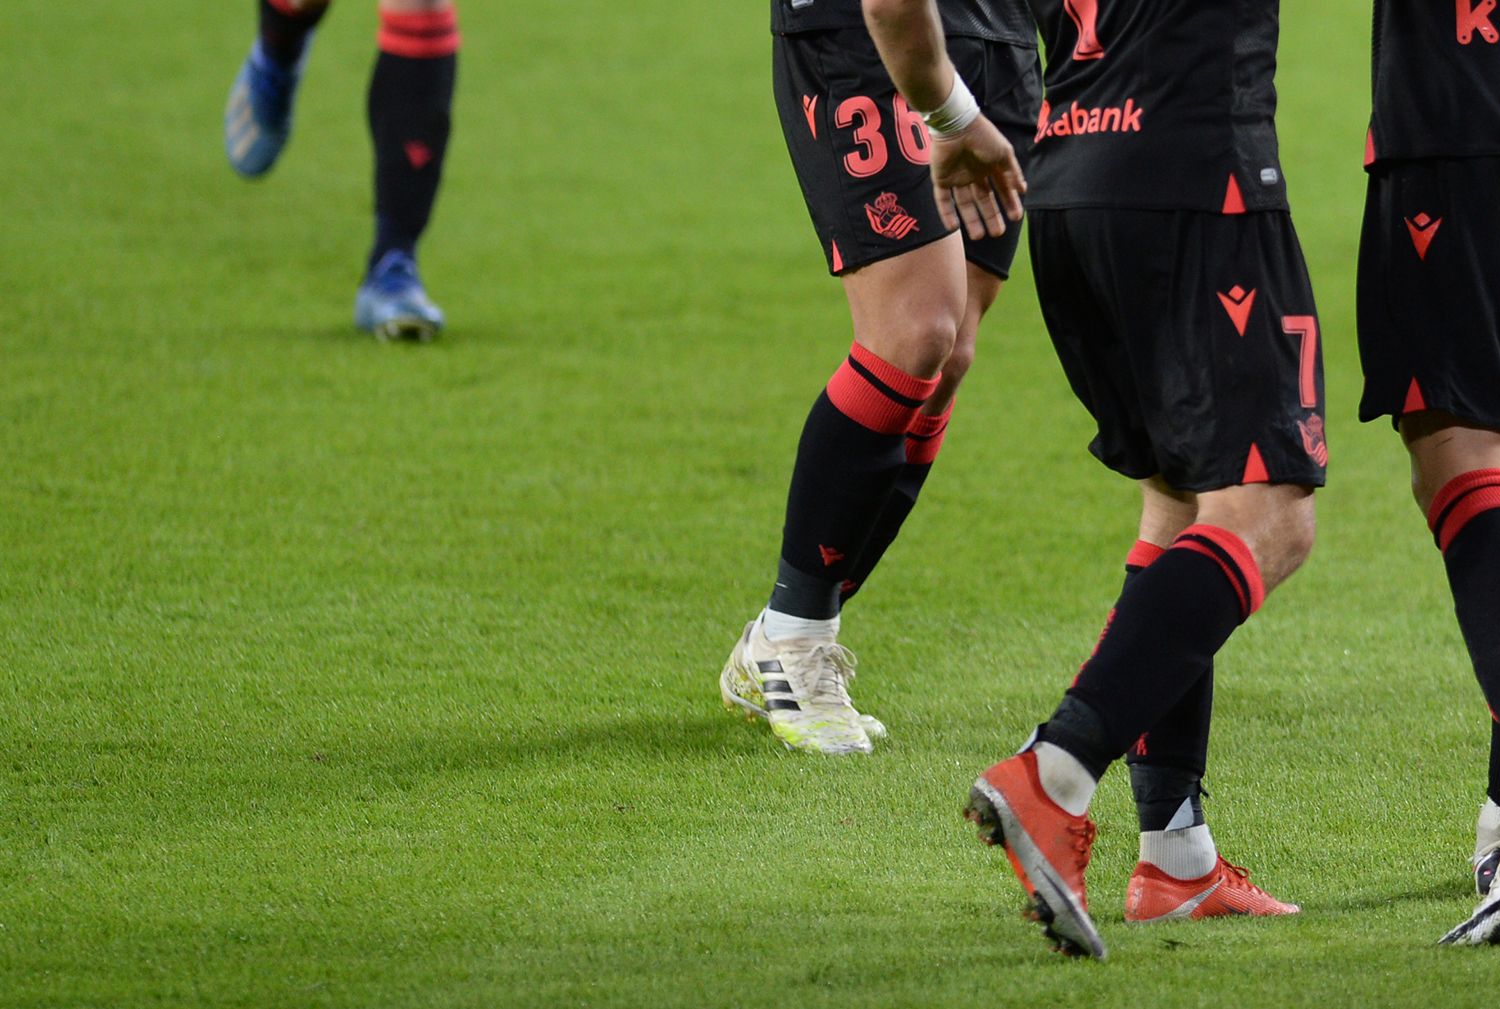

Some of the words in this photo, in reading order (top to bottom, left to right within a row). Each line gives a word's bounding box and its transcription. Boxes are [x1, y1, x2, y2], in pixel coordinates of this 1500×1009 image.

[834, 93, 930, 178] 36
[1034, 98, 1143, 144] abank
[1281, 315, 1317, 408] 7
